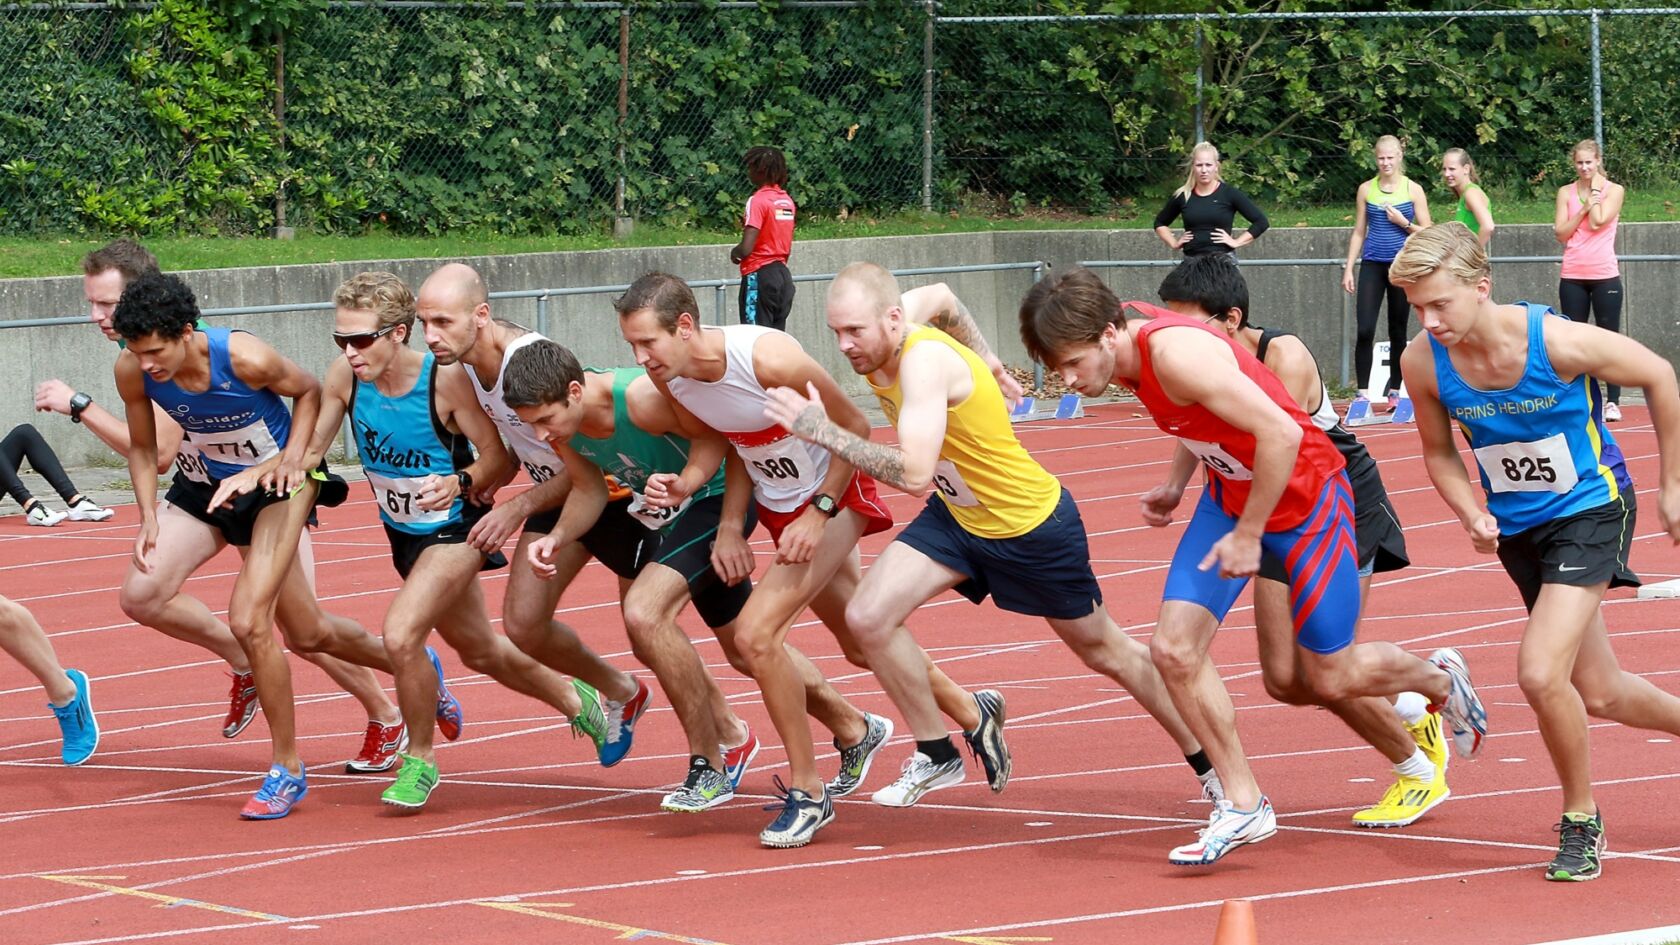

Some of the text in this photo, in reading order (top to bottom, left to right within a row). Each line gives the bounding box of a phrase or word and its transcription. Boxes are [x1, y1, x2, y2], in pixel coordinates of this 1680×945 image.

[1456, 393, 1558, 420] PRINS HENDRIK
[207, 440, 260, 458] 771
[363, 432, 431, 469] Vitalis
[1501, 457, 1557, 483] 825
